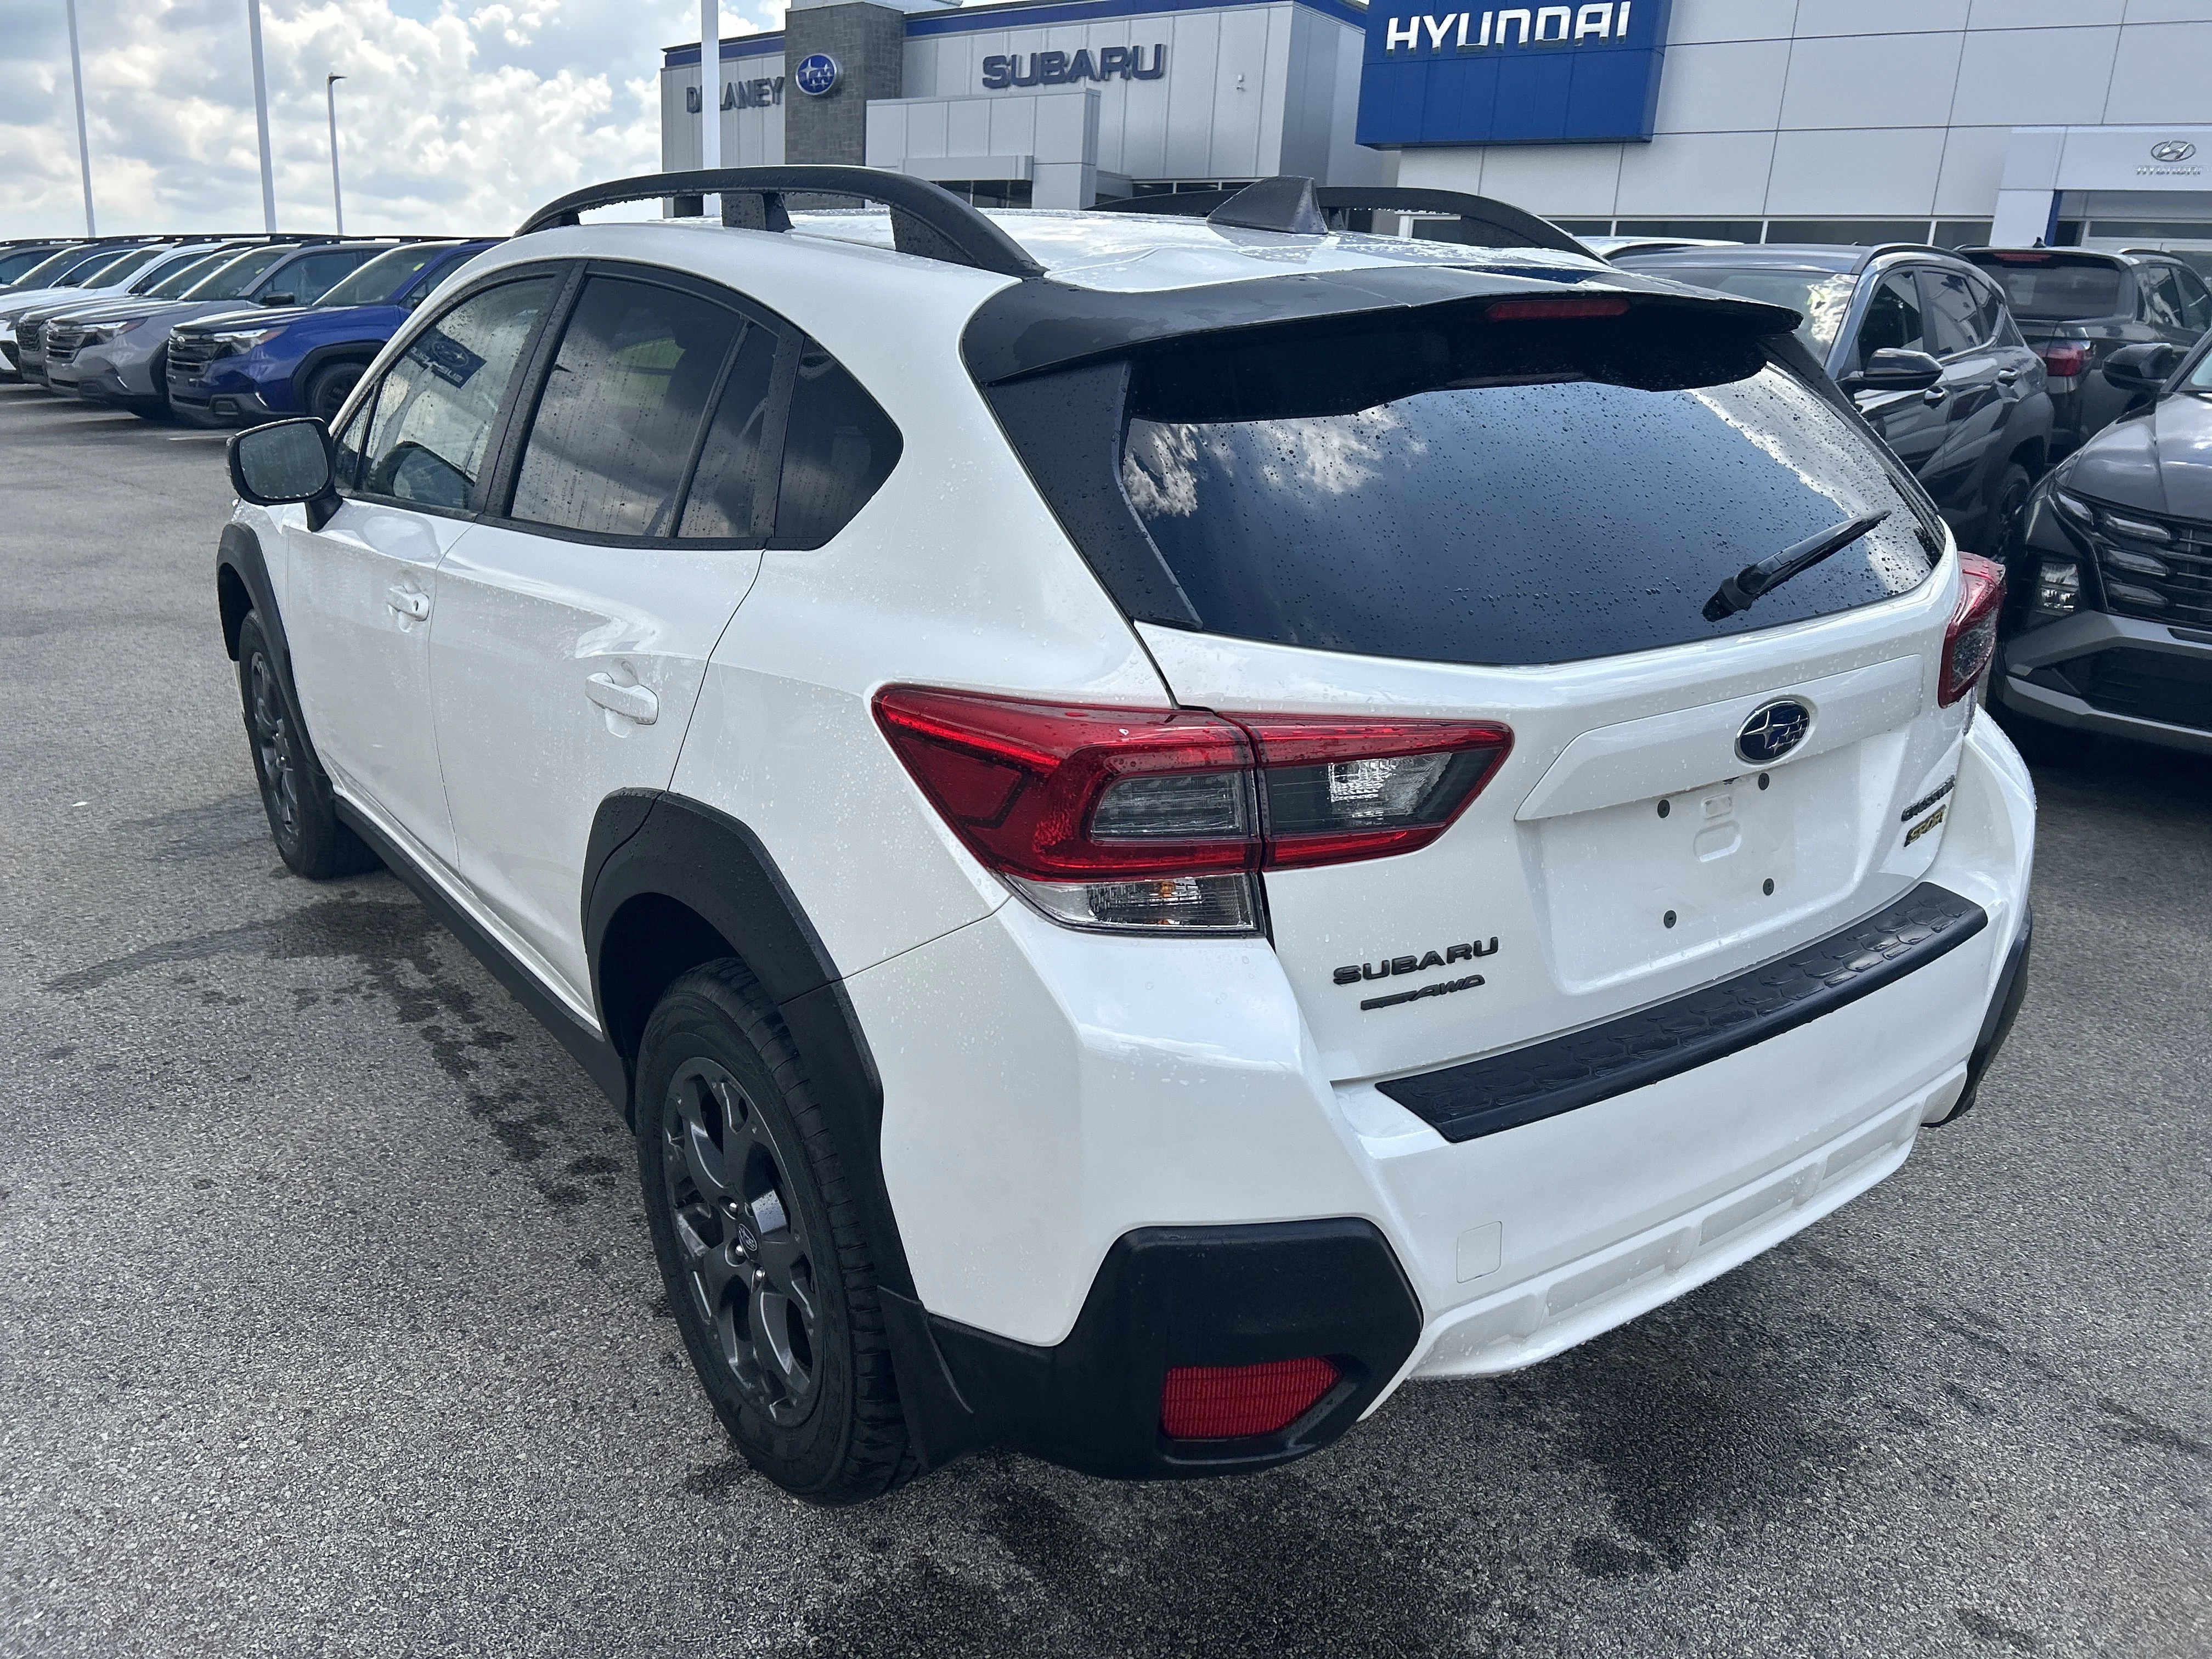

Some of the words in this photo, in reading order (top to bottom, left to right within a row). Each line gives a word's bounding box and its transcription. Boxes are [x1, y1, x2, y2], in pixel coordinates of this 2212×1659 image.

[1386, 1, 1631, 53] HYUNDAI
[982, 44, 1164, 89] SUBARU
[686, 76, 785, 113] DANEY
[1333, 936, 1498, 984] SUBARU
[1408, 974, 1485, 1001] AWD
